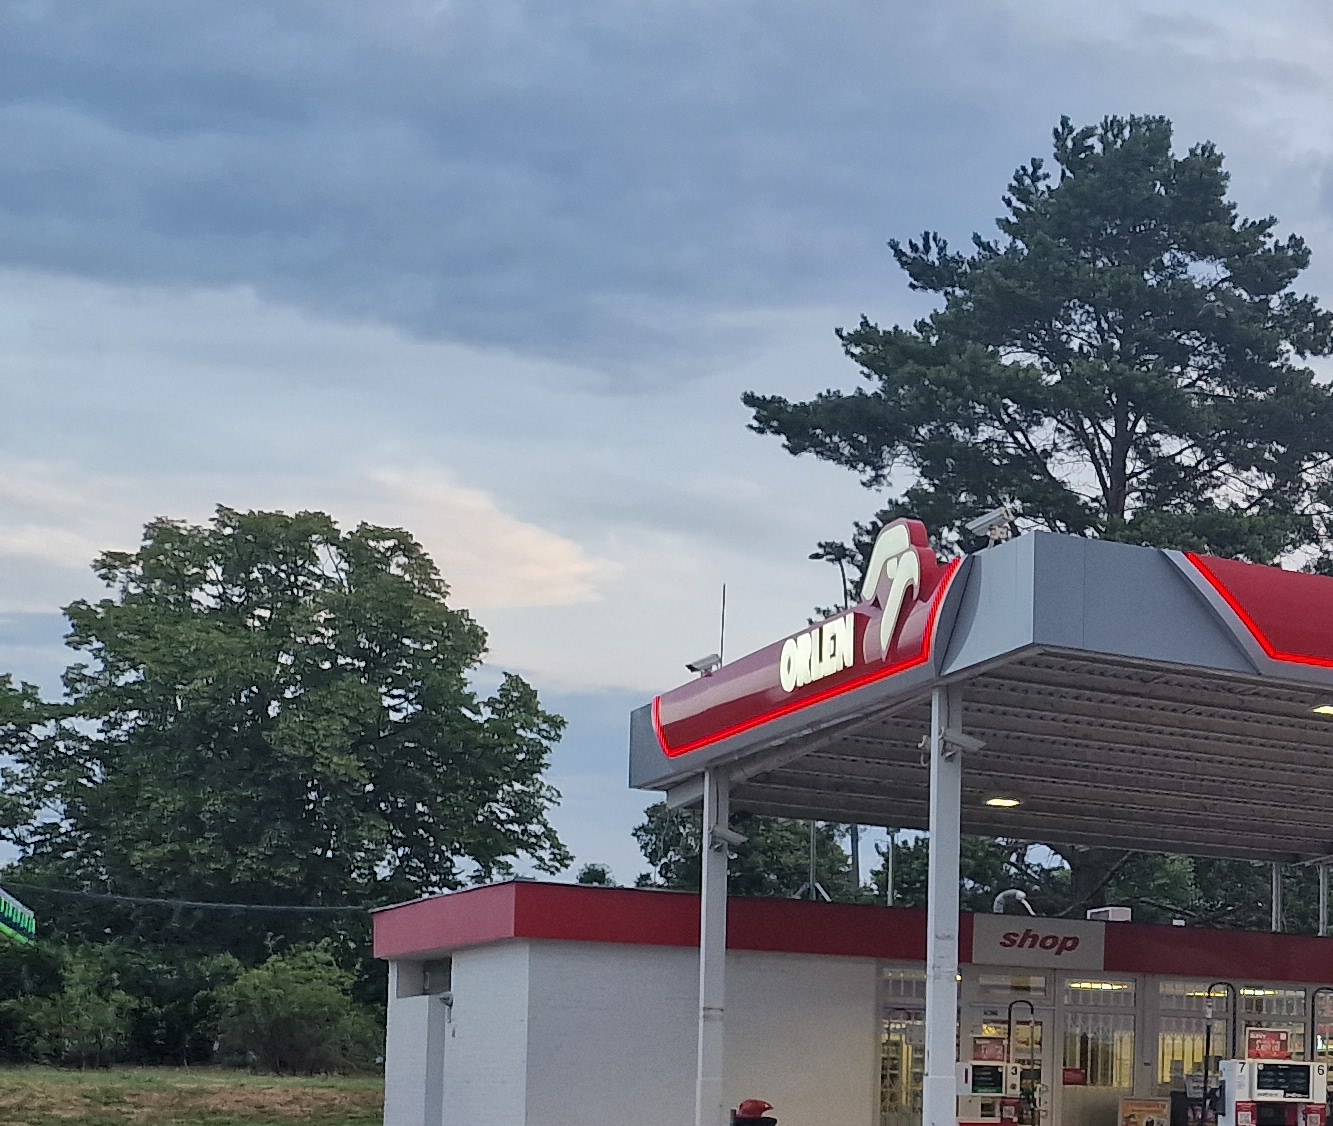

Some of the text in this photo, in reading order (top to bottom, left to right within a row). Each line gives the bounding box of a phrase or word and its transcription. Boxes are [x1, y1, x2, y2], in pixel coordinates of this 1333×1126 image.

[780, 612, 854, 692] ORLEN
[1000, 929, 1080, 955] shop
[1010, 1066, 1018, 1075] 3
[1238, 1062, 1246, 1073] 7
[1317, 1065, 1325, 1075] 6
